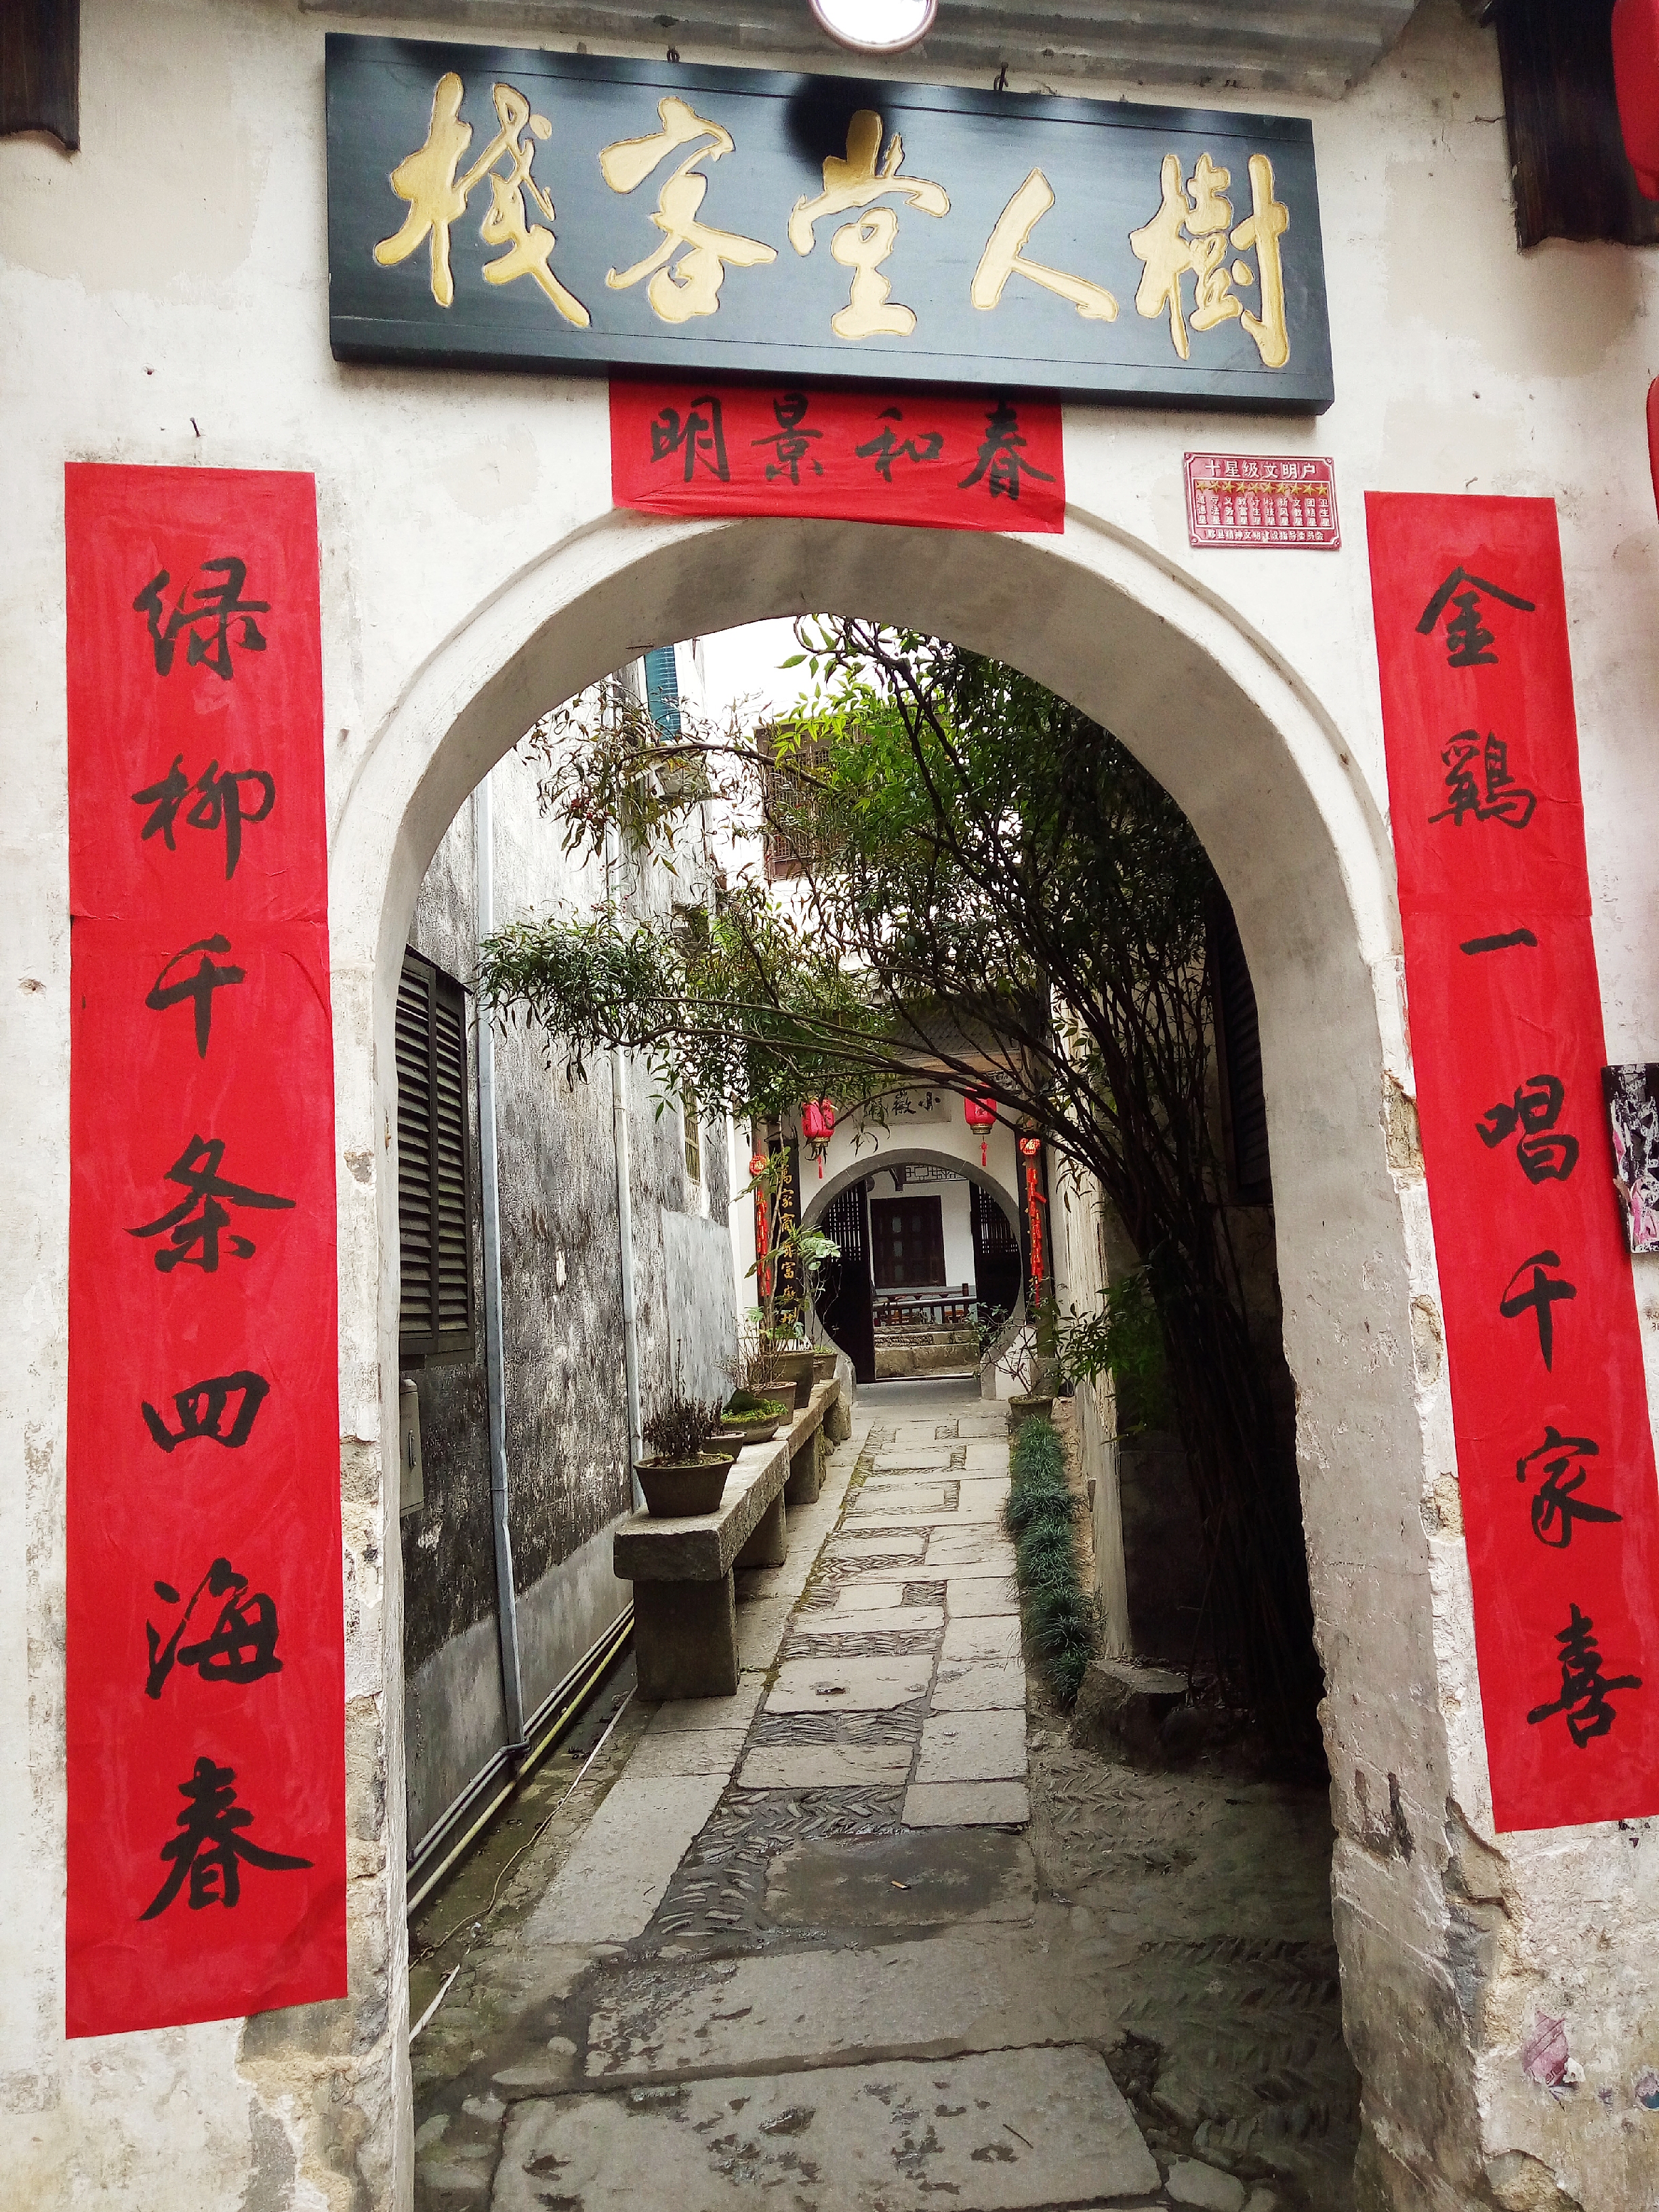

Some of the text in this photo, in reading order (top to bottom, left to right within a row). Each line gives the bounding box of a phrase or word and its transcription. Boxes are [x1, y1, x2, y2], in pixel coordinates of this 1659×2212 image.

[1205, 459, 1317, 479] 十星级文明户
